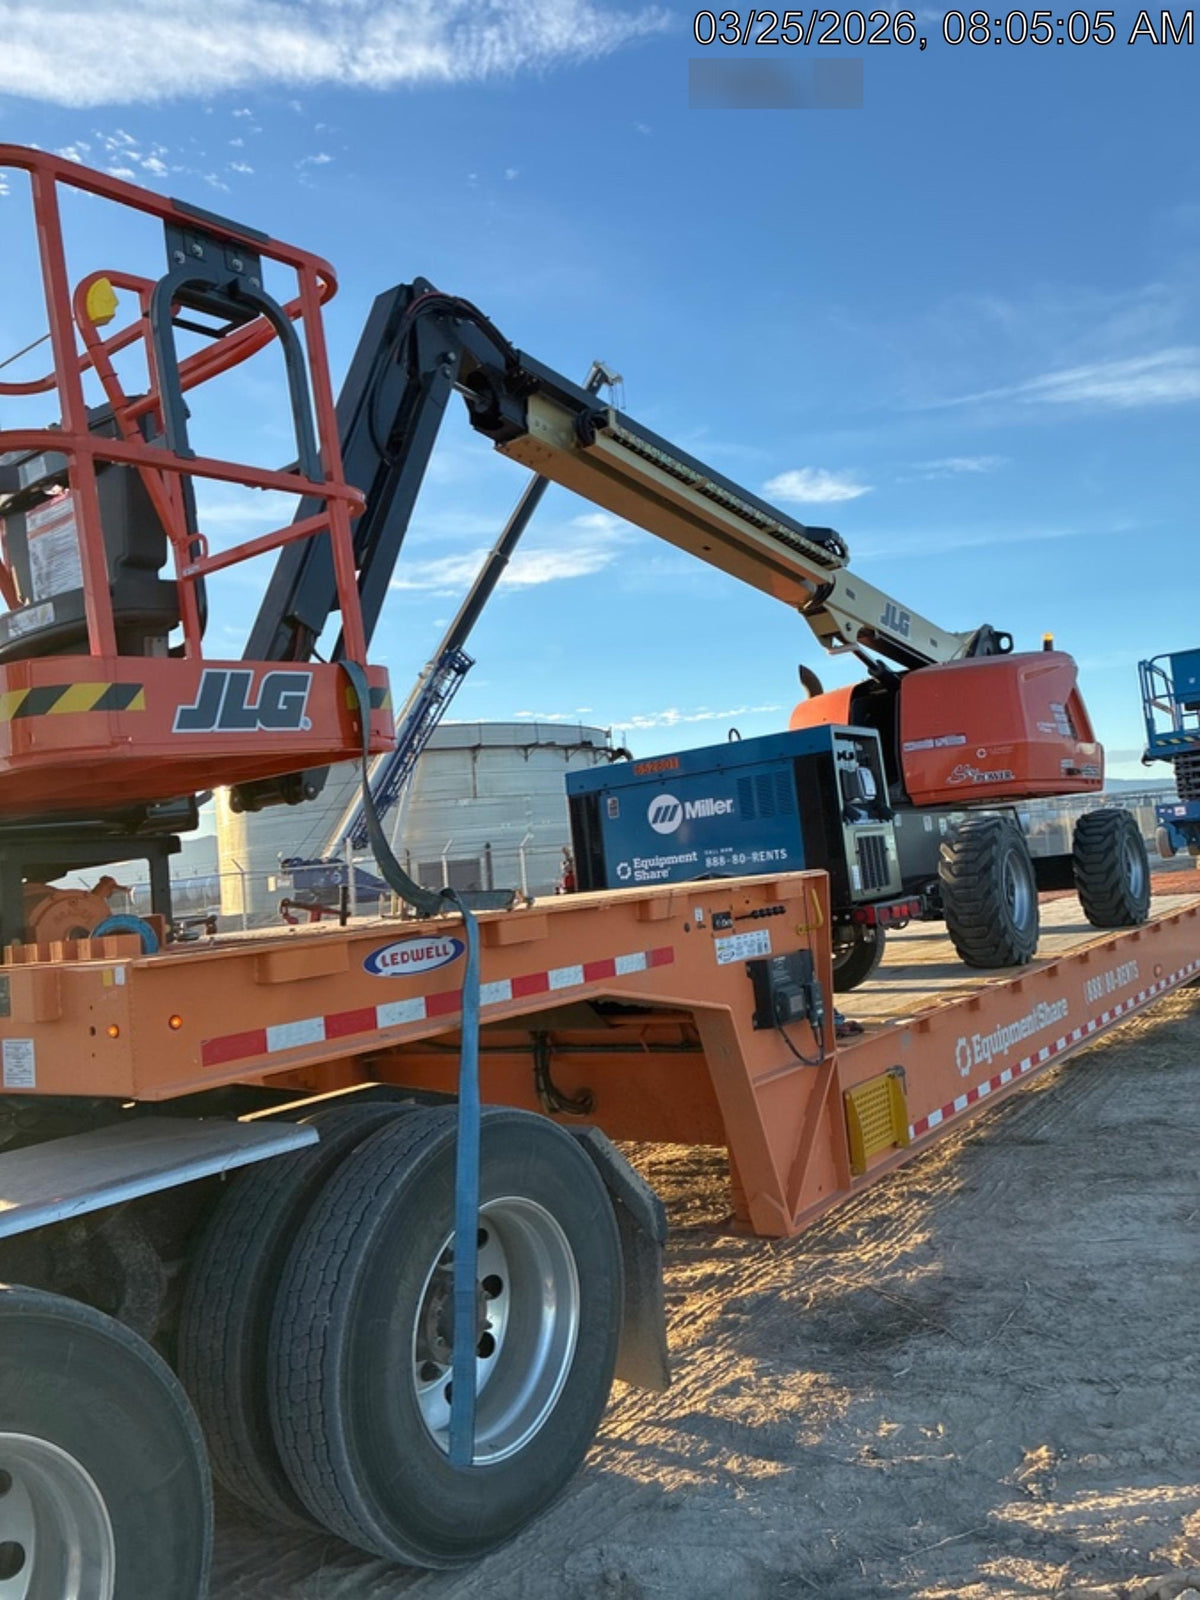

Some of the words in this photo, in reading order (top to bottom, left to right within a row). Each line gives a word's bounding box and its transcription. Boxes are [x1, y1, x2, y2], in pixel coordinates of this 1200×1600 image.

[880, 602, 910, 637] JLG
[172, 668, 312, 733] JLG
[684, 798, 733, 819] Miller
[633, 851, 698, 870] Equipment
[633, 868, 669, 881] Share
[381, 944, 450, 968] LEDWELL
[971, 998, 1068, 1065] EquipmentShare
